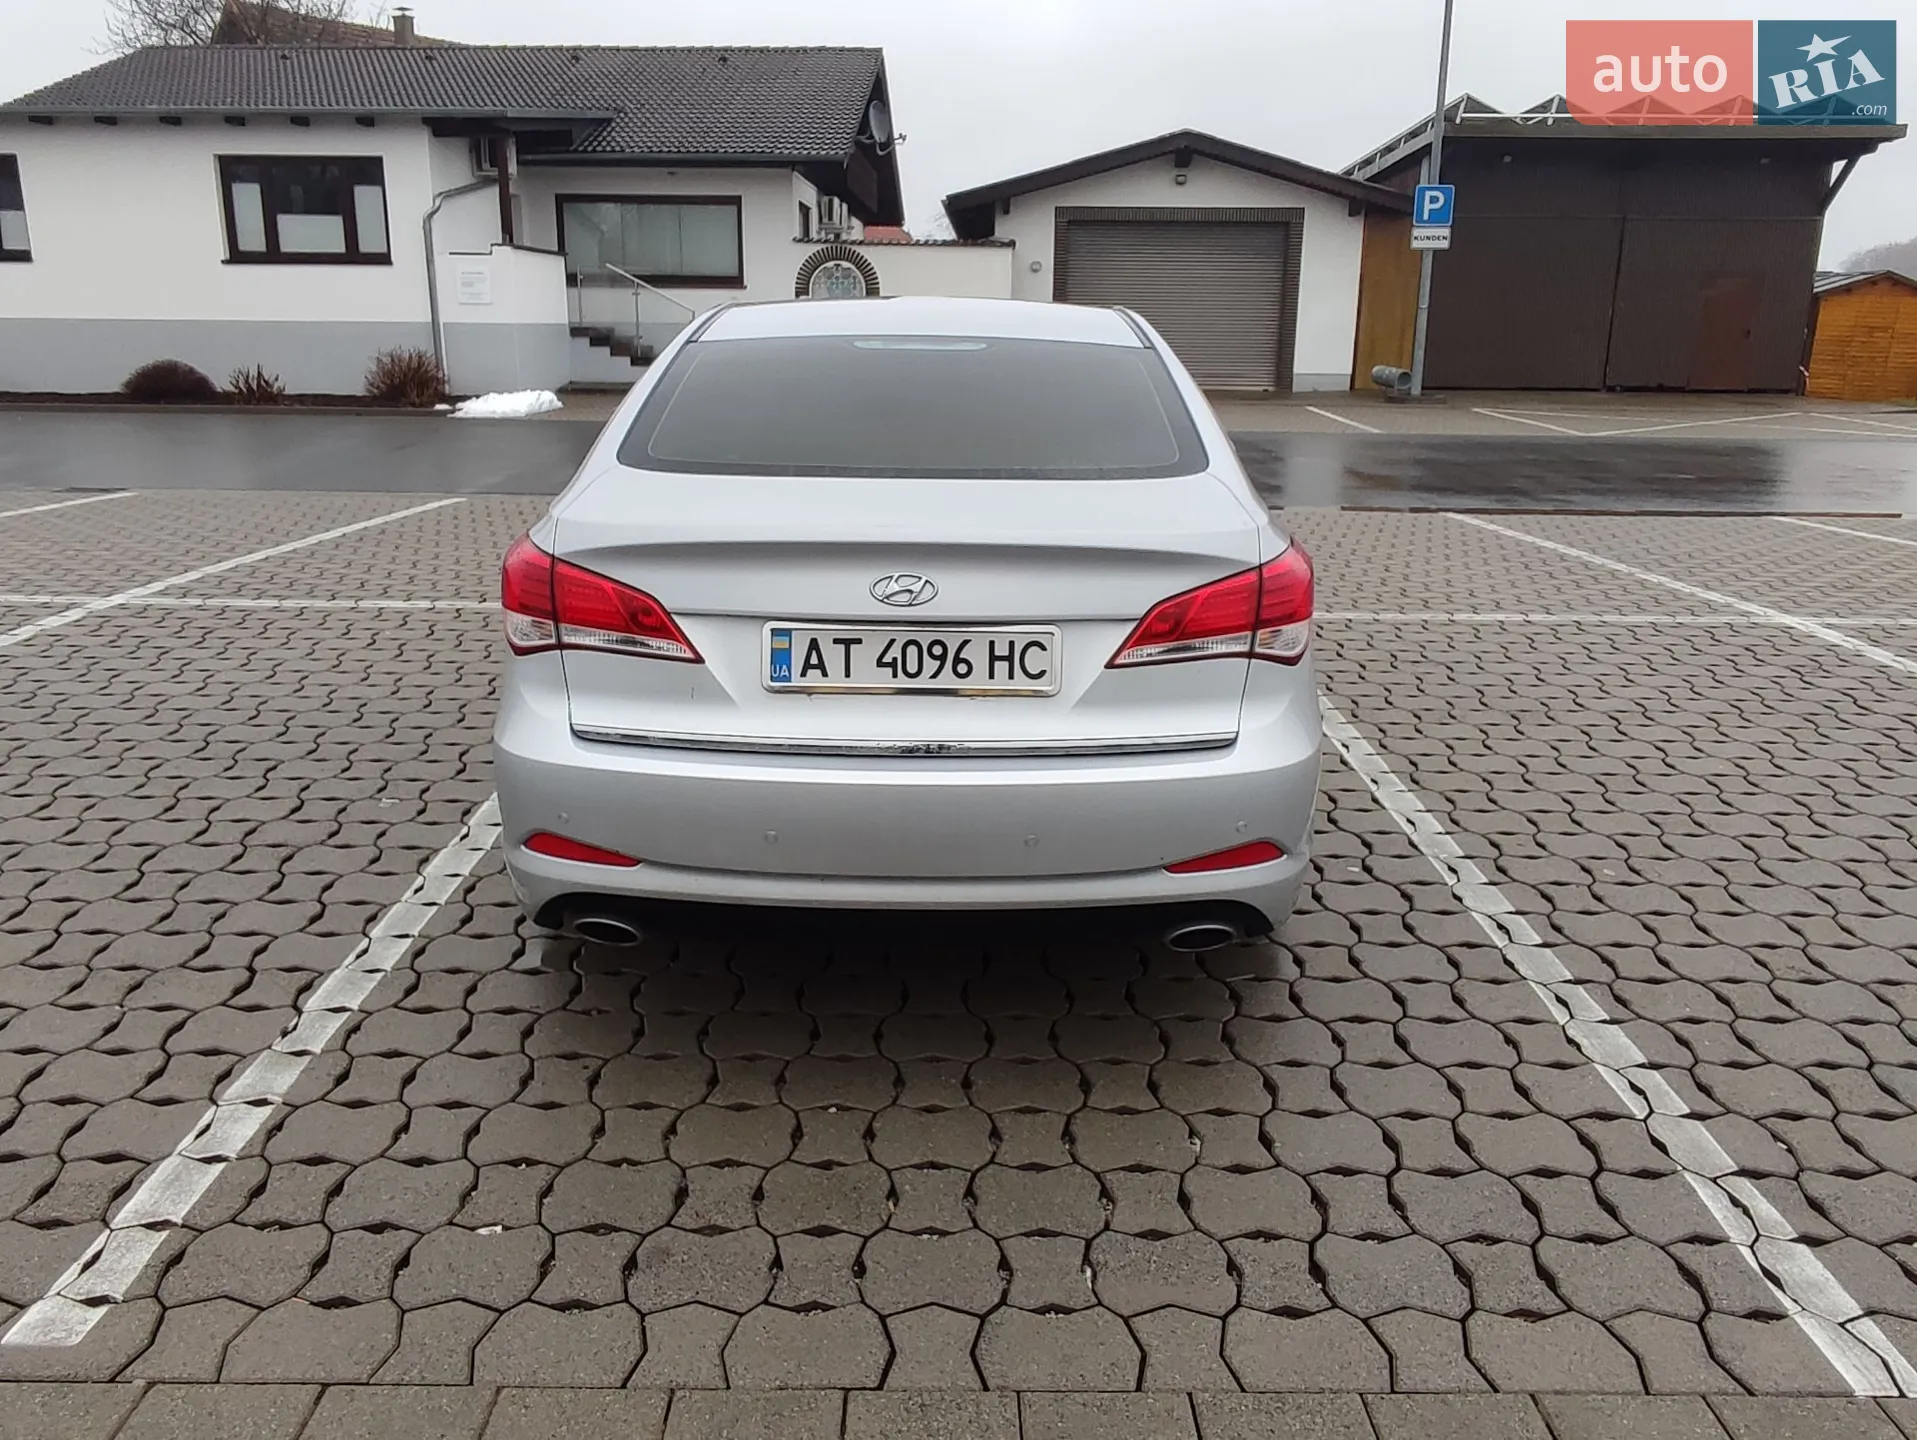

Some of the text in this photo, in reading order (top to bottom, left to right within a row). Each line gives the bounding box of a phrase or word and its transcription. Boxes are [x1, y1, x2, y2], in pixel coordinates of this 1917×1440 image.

[1423, 190, 1445, 221] P
[771, 664, 791, 679] UA
[799, 637, 1048, 681] AT 4096 HC
